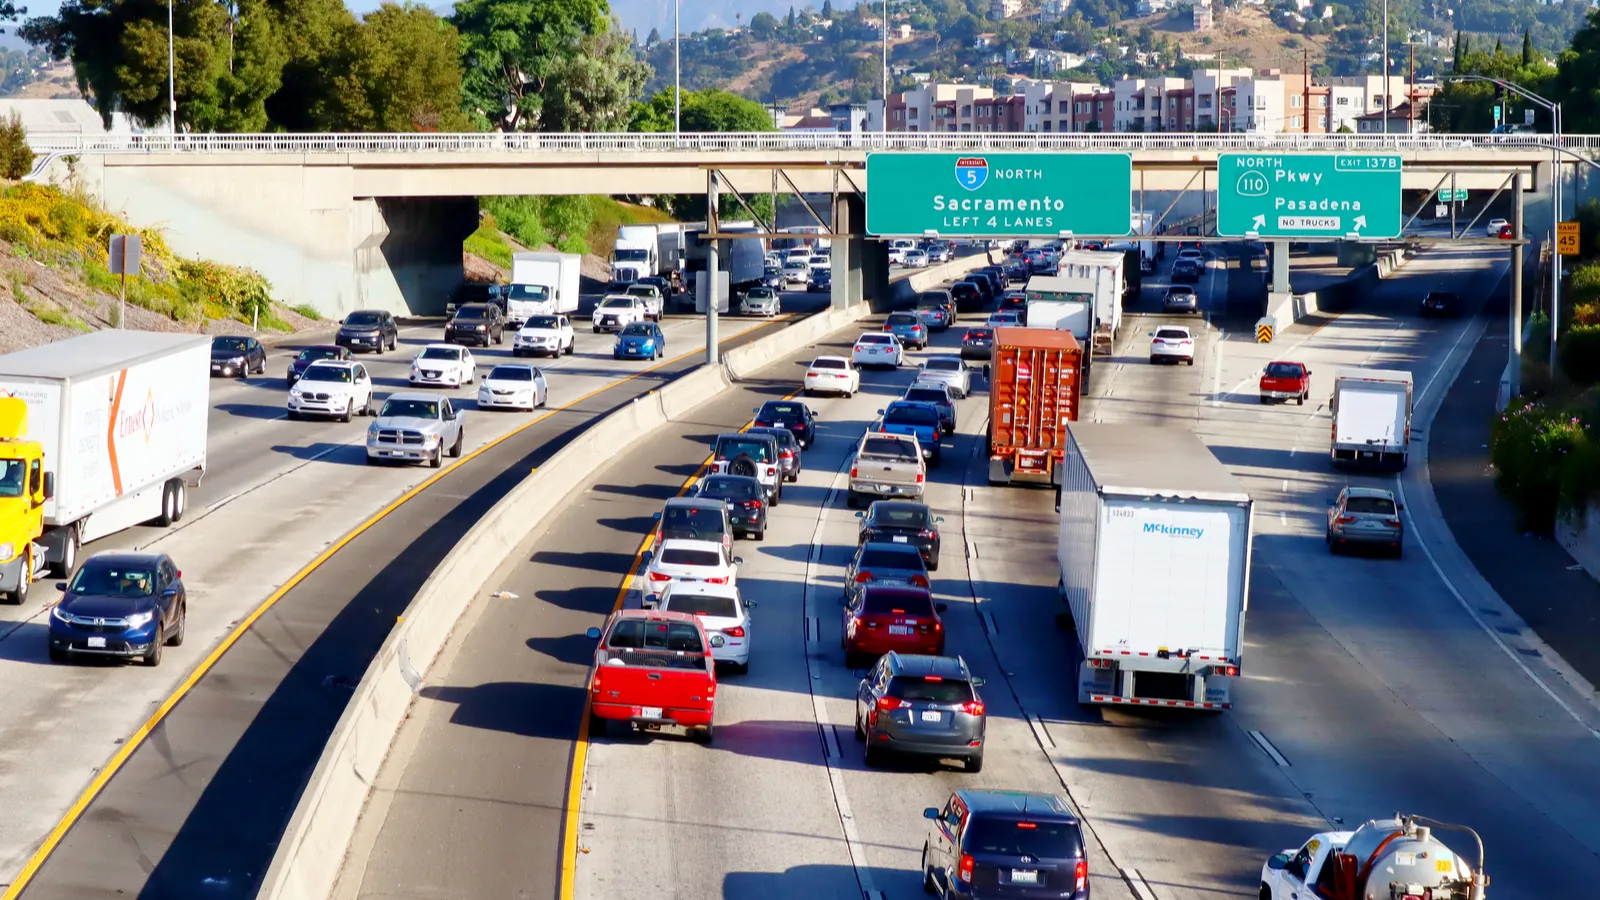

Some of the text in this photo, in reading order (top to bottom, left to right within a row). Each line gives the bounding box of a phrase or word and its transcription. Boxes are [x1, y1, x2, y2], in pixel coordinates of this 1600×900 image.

[1237, 158, 1282, 167] NORTH
[1340, 158, 1397, 167] EXIT 137B
[967, 170, 977, 185] 5
[995, 169, 1042, 179] NORTH
[1275, 170, 1323, 184] Pkwy
[1243, 179, 1263, 191] 110
[933, 195, 1064, 211] Sacramento
[1275, 198, 1361, 211] Pasadena
[944, 216, 1053, 228] LEFT 4 LANES
[1559, 236, 1576, 245] 45
[120, 409, 142, 438] Ernest
